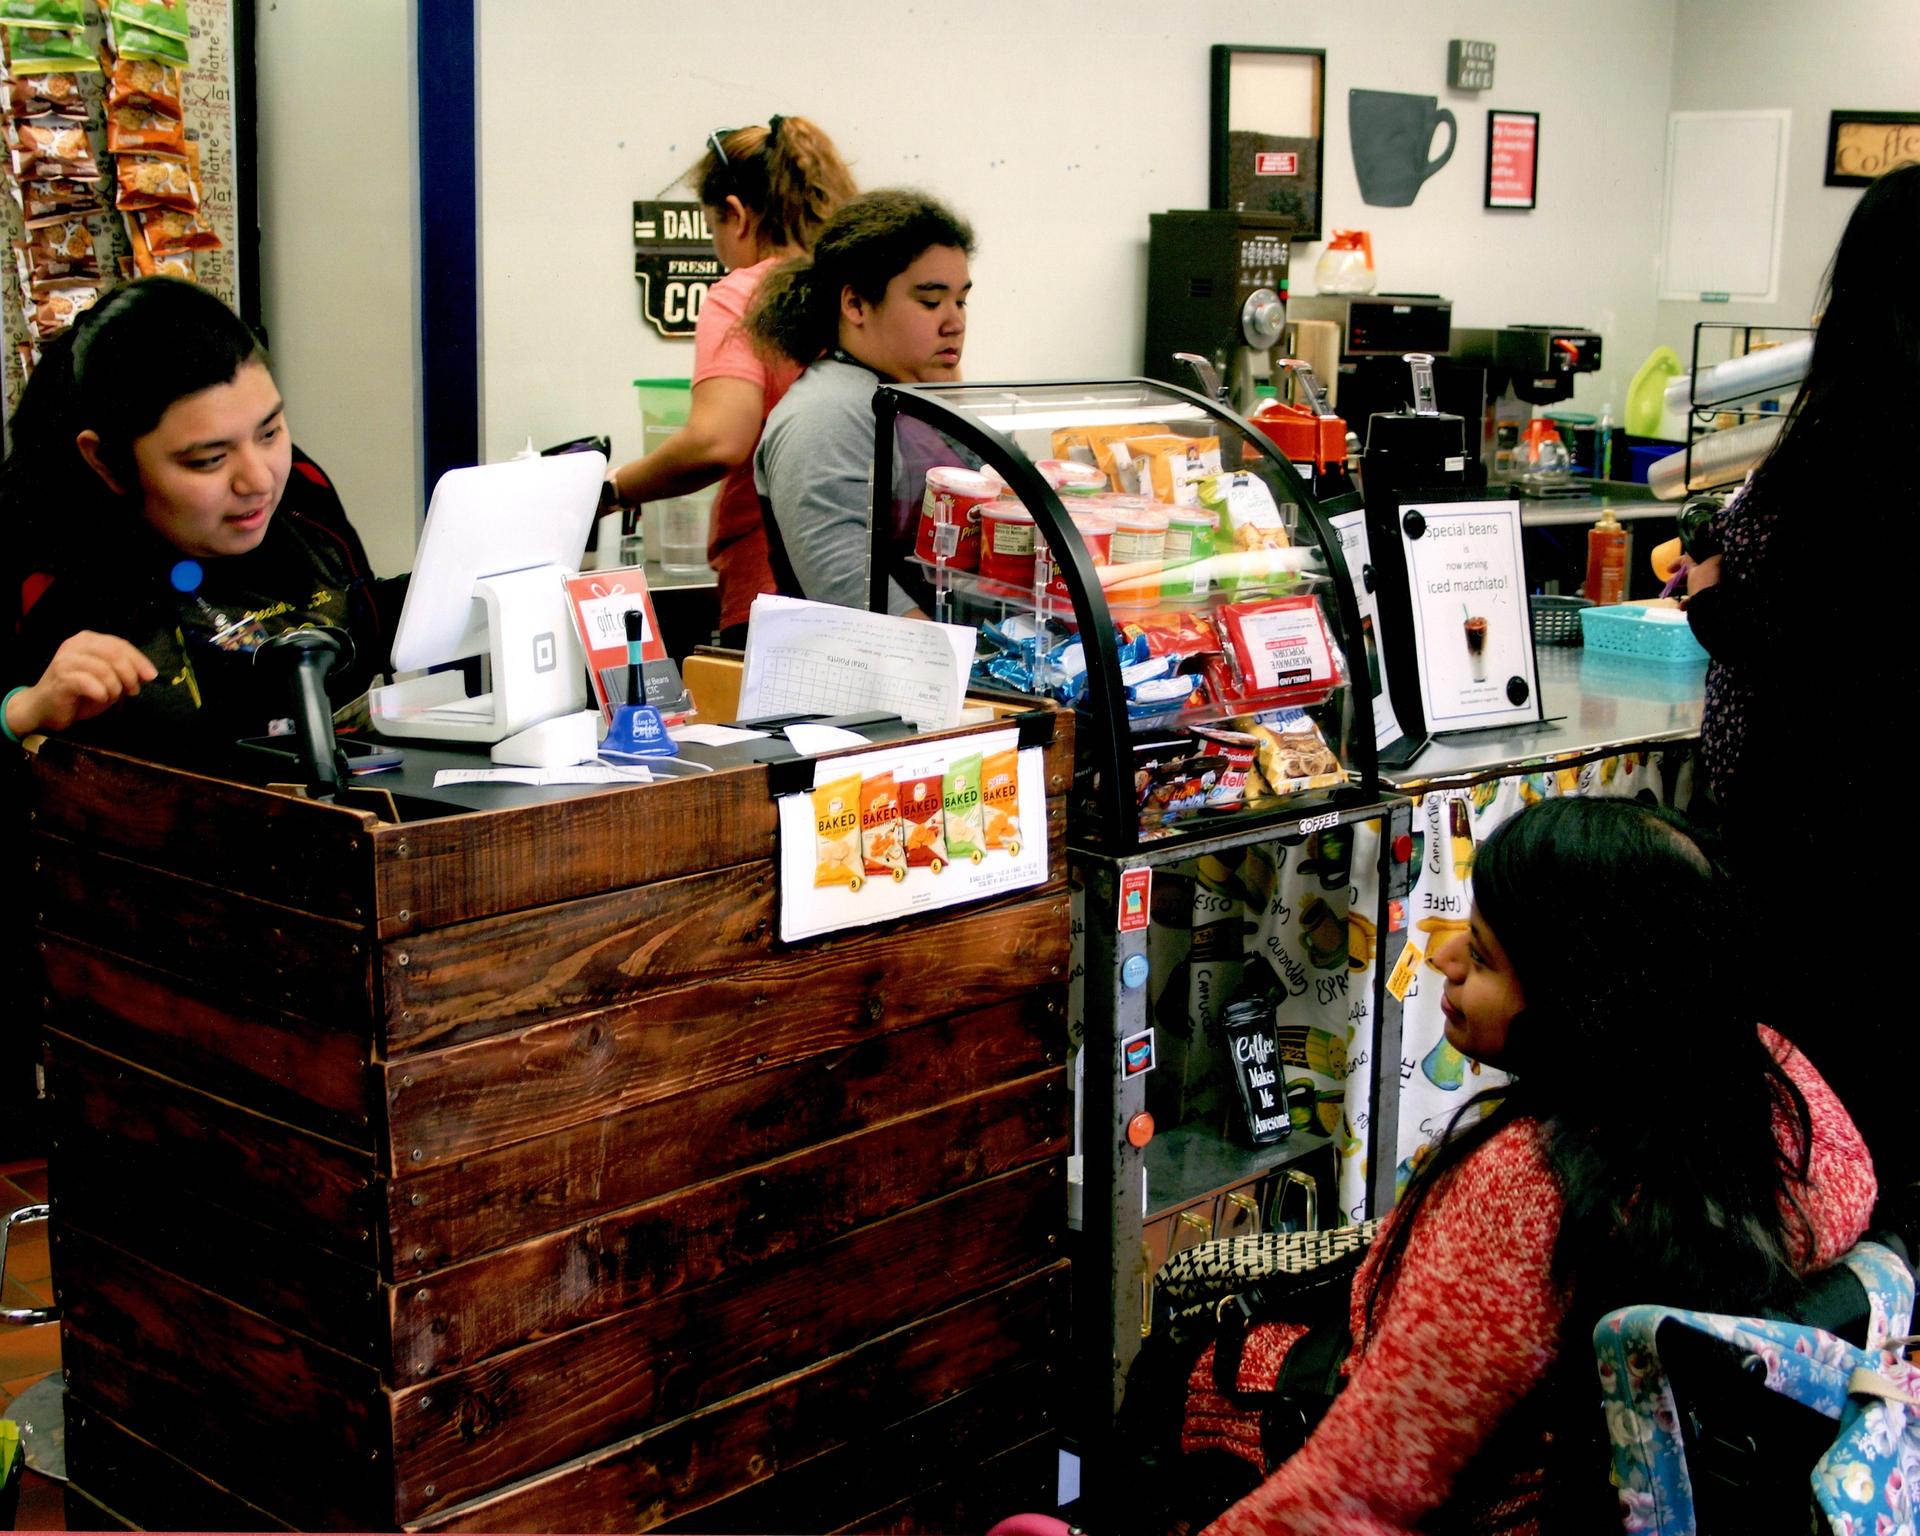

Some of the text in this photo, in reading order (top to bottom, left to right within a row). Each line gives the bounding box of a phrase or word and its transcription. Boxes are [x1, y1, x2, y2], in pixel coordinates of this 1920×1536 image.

[668, 261, 718, 274] FRESH
[1425, 521, 1499, 540] Special beans
[1446, 561, 1462, 571] now
[1427, 575, 1509, 594] iced macchiato!
[597, 607, 617, 638] gift
[1272, 647, 1306, 657] POPCORN
[827, 655, 869, 670] Total Points
[1271, 655, 1313, 670] MICROWAVE
[651, 675, 669, 686] Beans
[646, 686, 660, 695] CTC
[945, 790, 978, 809] BAKED
[983, 784, 1017, 803] BAKED
[863, 807, 898, 826] BAKED
[903, 798, 939, 817] BAKED
[818, 812, 856, 832] BAKED
[1299, 812, 1338, 835] COFFEE
[850, 879, 857, 888] 8
[895, 869, 901, 879] 8
[1236, 1031, 1275, 1065] Coffee
[1248, 1065, 1277, 1089] Makes
[1258, 1089, 1275, 1109] Me
[1255, 1112, 1290, 1135] Awesome
